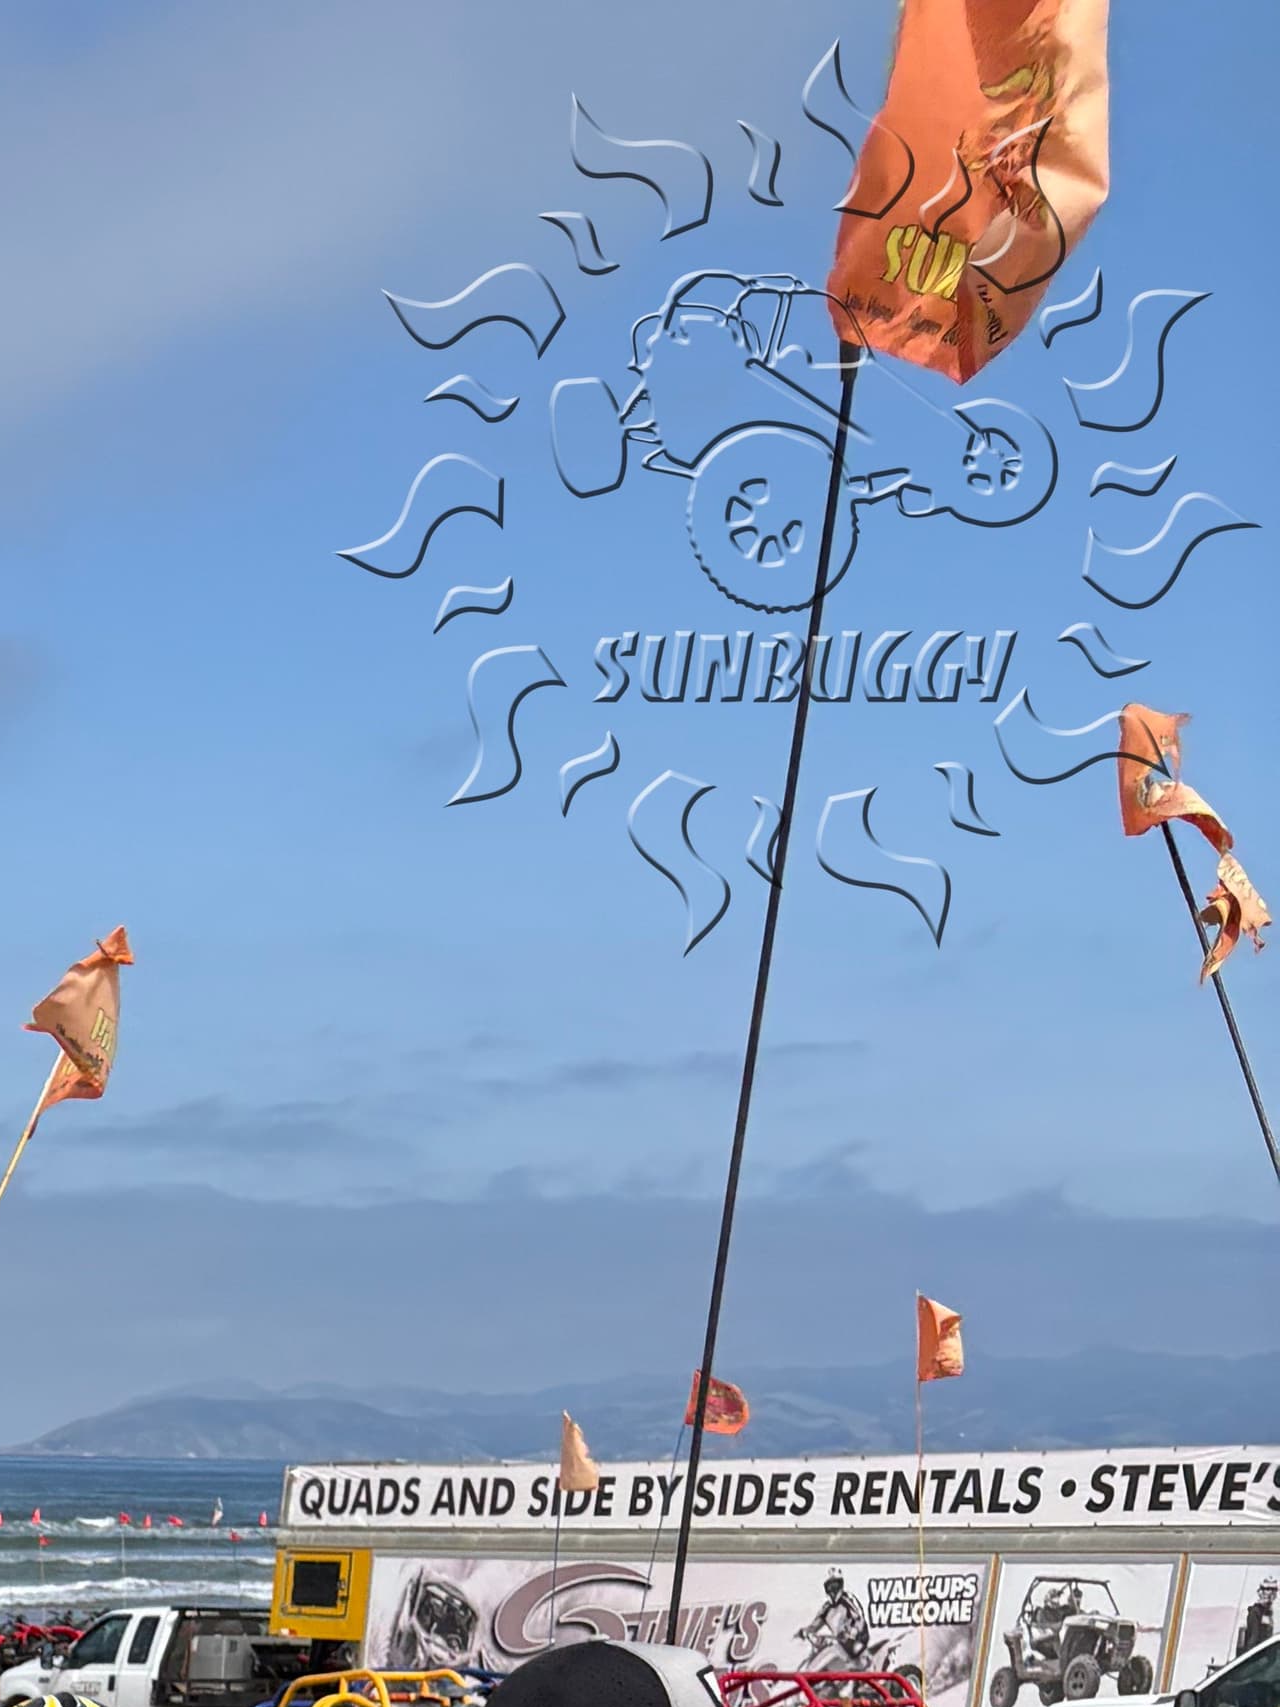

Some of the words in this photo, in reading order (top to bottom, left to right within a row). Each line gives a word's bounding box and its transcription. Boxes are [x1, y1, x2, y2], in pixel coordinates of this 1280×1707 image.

[299, 1476, 420, 1519] QUADS
[431, 1476, 517, 1516] AND
[527, 1475, 617, 1518] SIDE
[628, 1473, 685, 1516] BY
[692, 1471, 817, 1517] SIDES
[829, 1466, 1045, 1516] RENTALS
[868, 1574, 978, 1602] WALK-UPS
[868, 1600, 974, 1627] WELCOME
